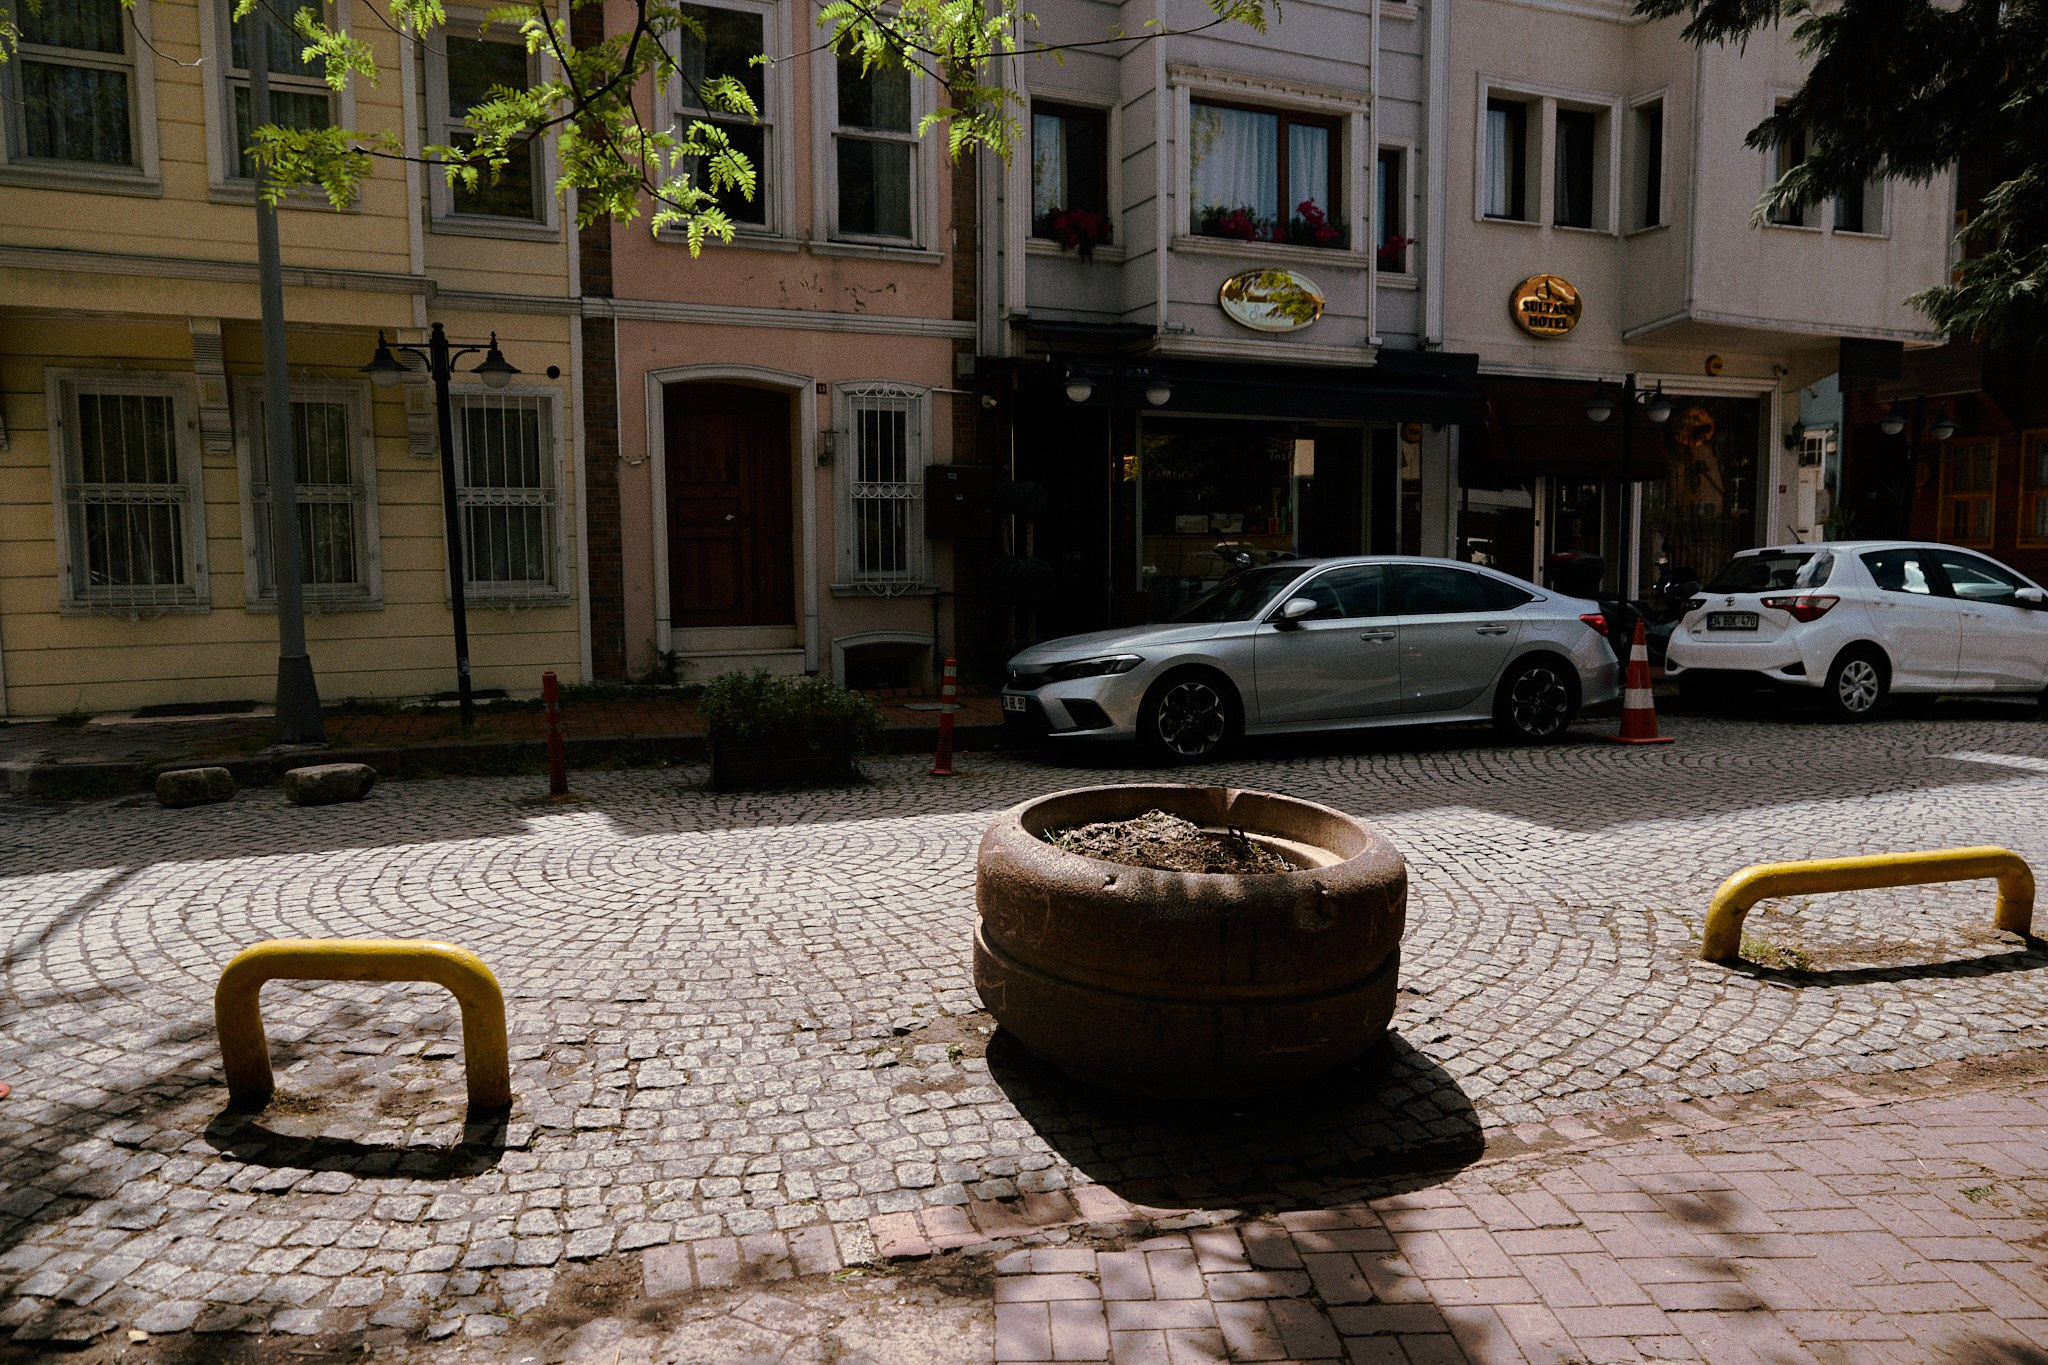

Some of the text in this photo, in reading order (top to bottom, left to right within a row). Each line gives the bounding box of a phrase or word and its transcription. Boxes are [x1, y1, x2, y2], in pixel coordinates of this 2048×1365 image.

[1523, 301, 1575, 315] SULTANS
[1529, 315, 1569, 329] HOTEL
[818, 385, 826, 393] 13
[1711, 616, 1721, 626] 34
[1741, 616, 1755, 626] 470
